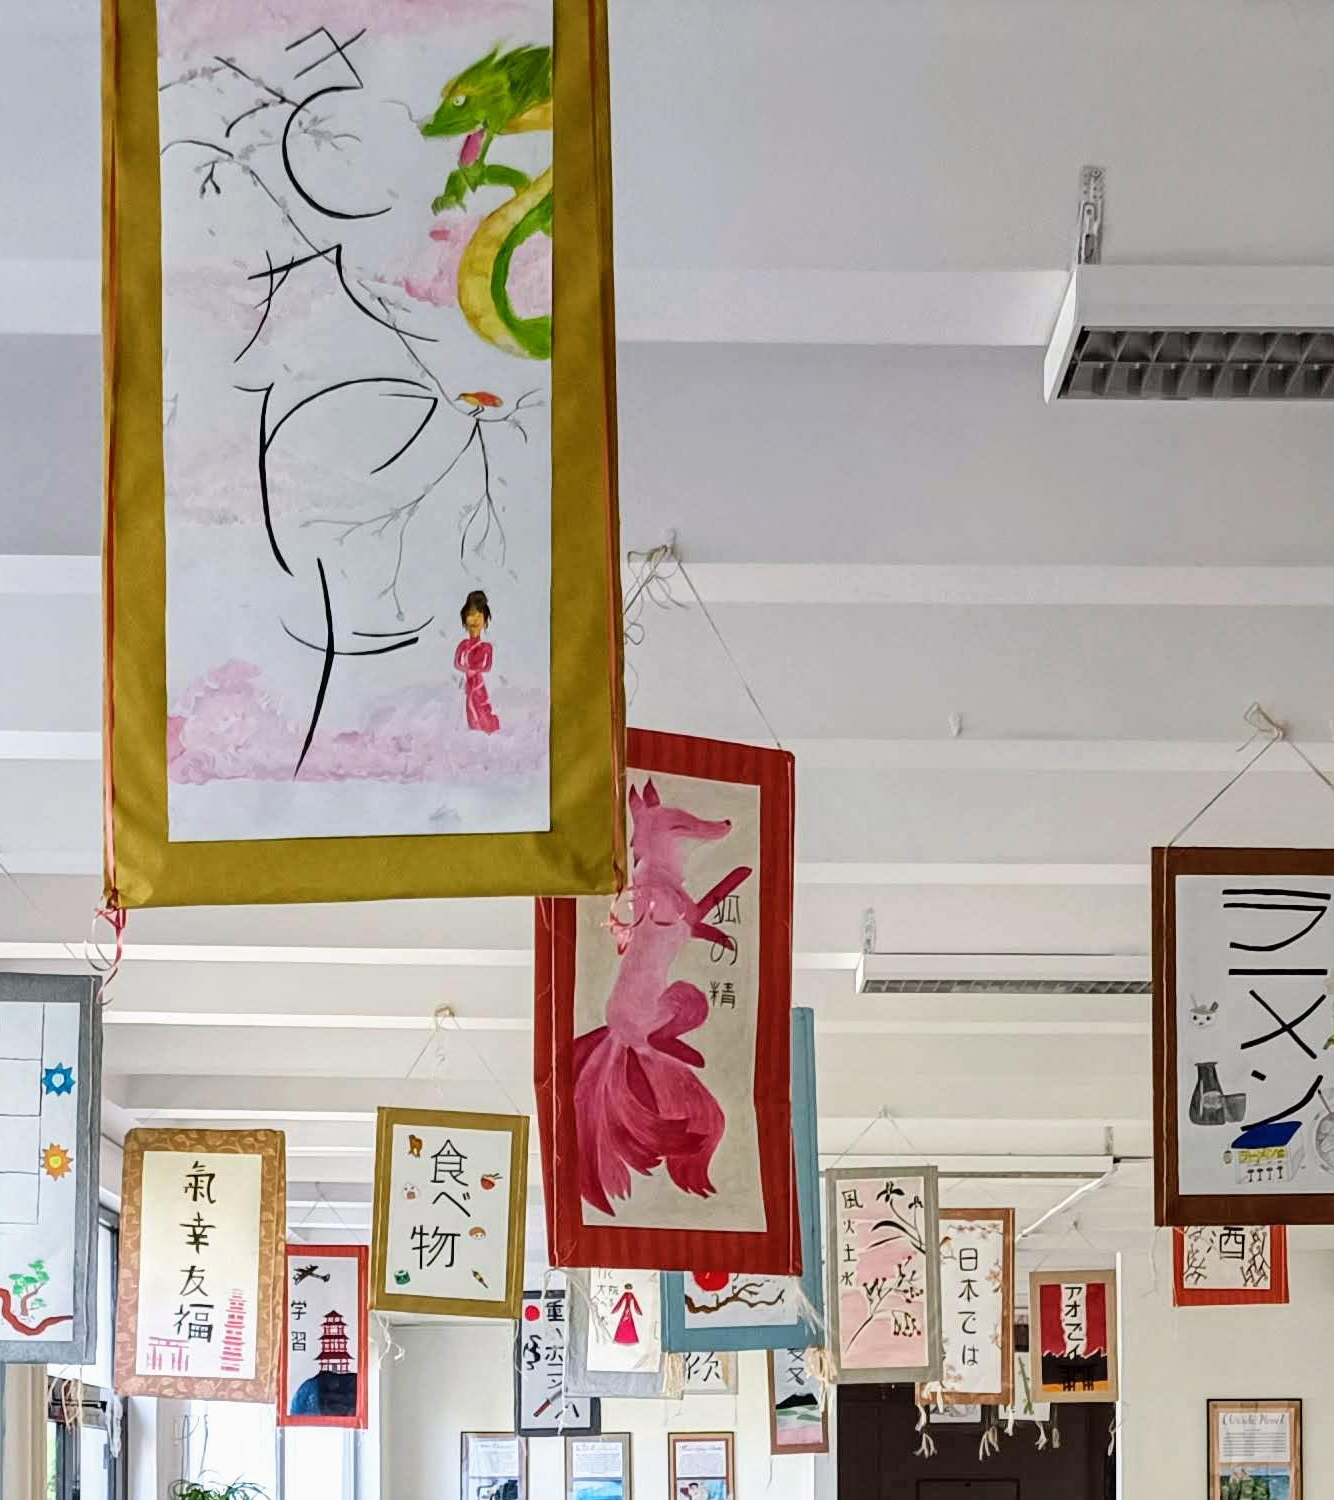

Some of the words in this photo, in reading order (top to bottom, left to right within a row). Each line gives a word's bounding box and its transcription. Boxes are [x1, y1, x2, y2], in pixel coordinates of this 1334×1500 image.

[1222, 888, 1331, 1132] ラーメン
[410, 1139, 471, 1270] 食べ物
